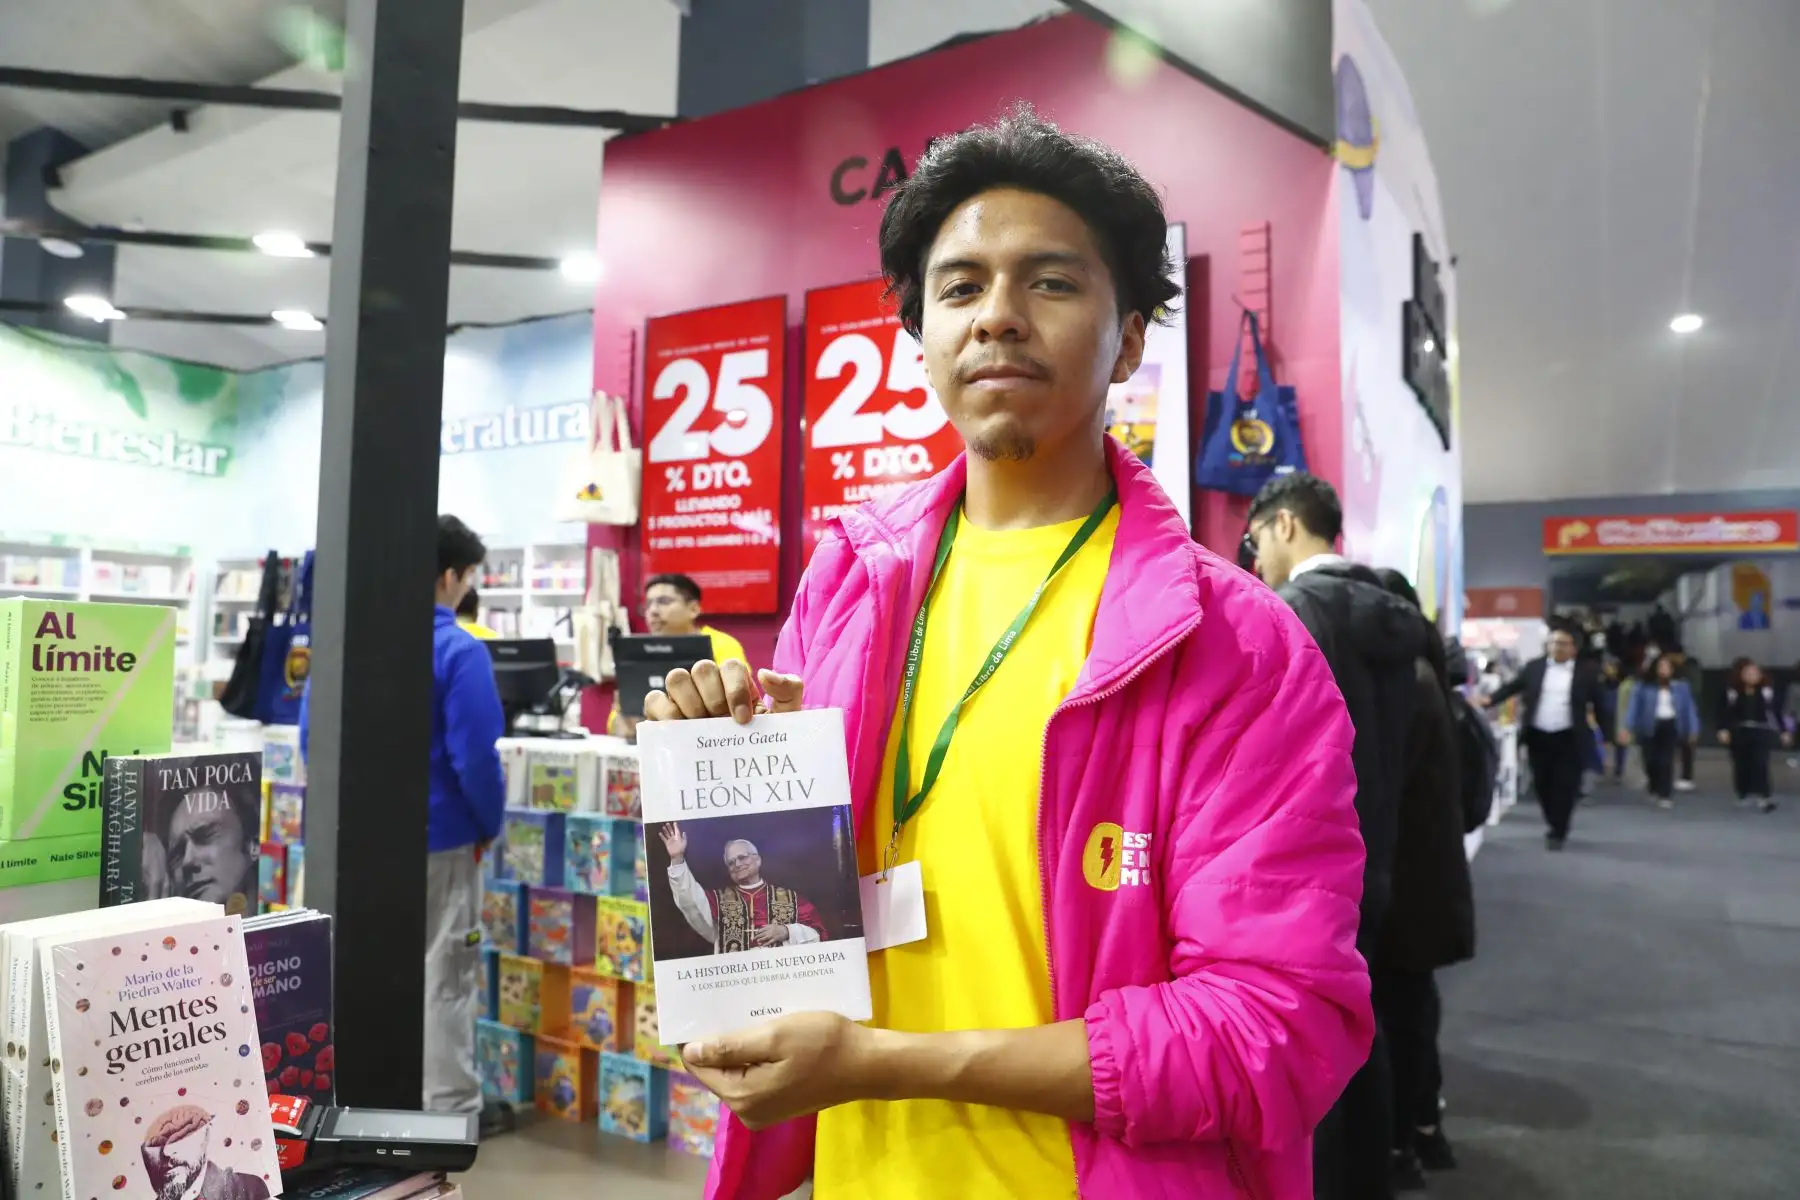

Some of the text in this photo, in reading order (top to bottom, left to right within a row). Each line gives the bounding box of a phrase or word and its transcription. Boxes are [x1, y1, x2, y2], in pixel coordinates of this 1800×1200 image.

[812, 328, 949, 449] 25
[649, 348, 773, 464] 25
[3, 402, 228, 476] Bienestar
[664, 460, 752, 492] % DTO.
[830, 444, 934, 480] % DTO.
[34, 611, 76, 639] Al
[915, 627, 923, 637] de
[32, 643, 137, 673] límite
[910, 638, 921, 661] Libro
[975, 664, 995, 686] Libro
[993, 652, 1003, 664] de
[998, 630, 1017, 651] Lima
[907, 663, 915, 677] del
[696, 731, 788, 749] Saverio Gaeta
[159, 762, 253, 791] TAN POCA
[695, 753, 798, 782] EL PAPA
[123, 771, 138, 834] HANYA
[184, 790, 231, 815] VIDA
[680, 778, 816, 811] LEÓN XIV
[106, 771, 123, 893] YANAGIHARA
[124, 964, 194, 987] Mario de la
[263, 975, 277, 985] ser
[677, 951, 846, 981] LA HISTORIA DEL NUEVO PAPA
[698, 981, 714, 991] LOS
[715, 978, 740, 989] RETOS
[741, 976, 758, 986] QUE
[792, 967, 835, 979] AFRONTAR
[118, 976, 203, 1002] Piedra Walter
[109, 995, 219, 1038] Mentes
[750, 1006, 783, 1017] OCÉANO
[105, 1021, 227, 1075] geniales
[135, 1075, 163, 1087] cerebro
[163, 1070, 173, 1079] de
[173, 1067, 183, 1078] los
[141, 1064, 163, 1076] Cómo
[163, 1057, 193, 1071] funciona
